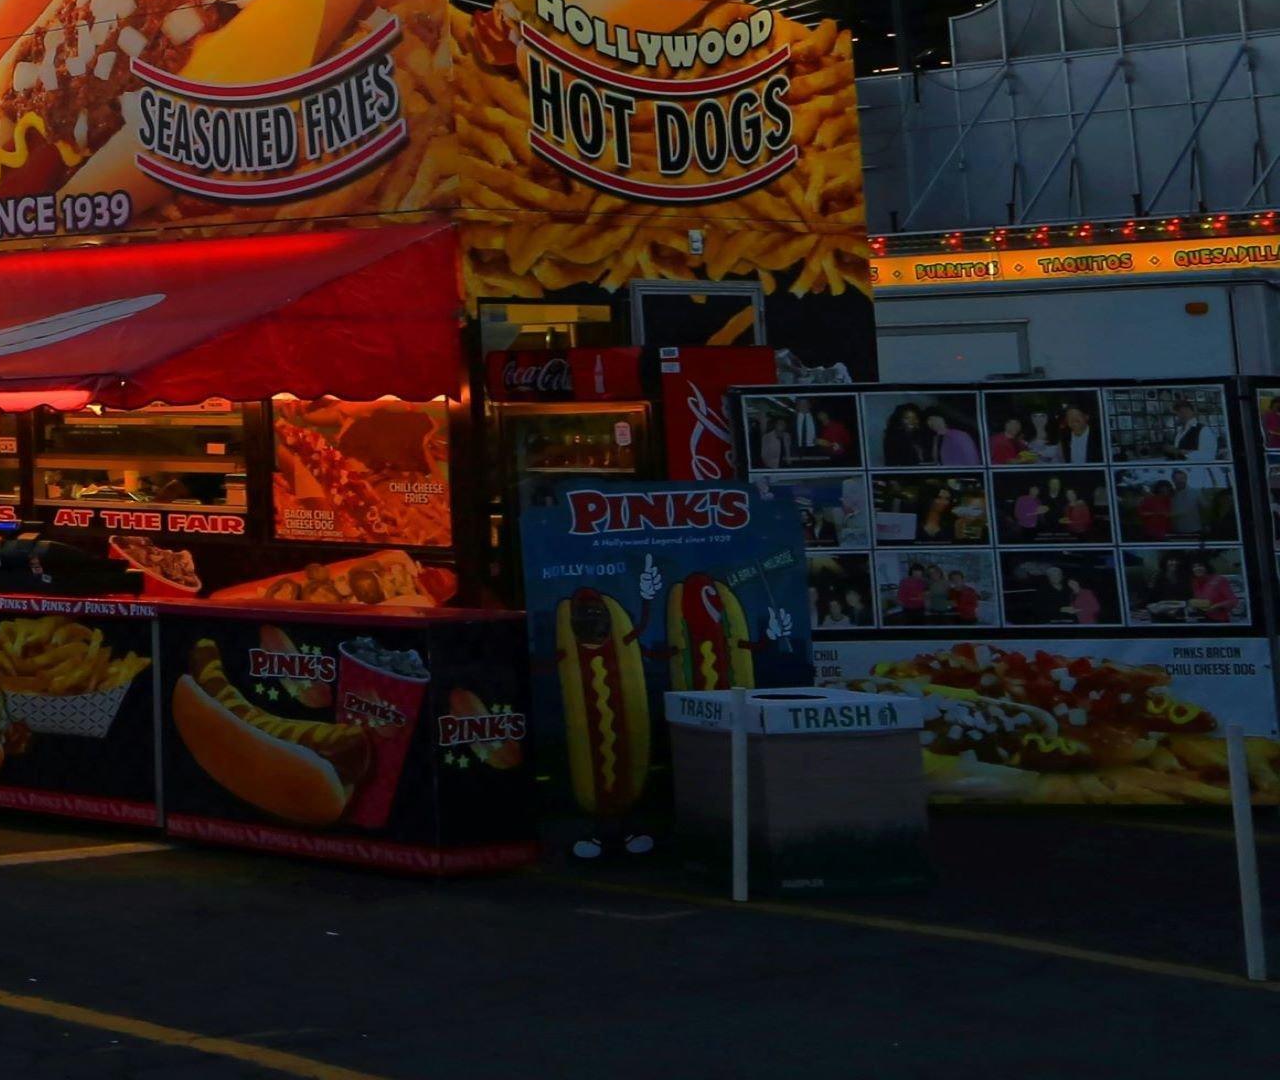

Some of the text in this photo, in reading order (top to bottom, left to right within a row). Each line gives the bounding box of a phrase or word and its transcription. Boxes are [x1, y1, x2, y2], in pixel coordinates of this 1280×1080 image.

[138, 53, 399, 171] SEASONED FRIES
[527, 55, 793, 175] HOT DOGS
[61, 190, 130, 230] 1939
[915, 260, 999, 280] BURRITOS
[1038, 253, 1132, 273] TAQUITOS
[54, 509, 245, 535] AT THE FAIR
[314, 510, 334, 521] CHILI
[566, 489, 750, 535] PINK'S
[285, 519, 334, 530] CHEESE DOG
[543, 563, 626, 579] HOLLYWOOD
[1173, 647, 1242, 658] PINKS BACON
[249, 648, 335, 682] PINK'S
[1166, 663, 1256, 675] CHILI CHEESE DOG
[344, 692, 406, 728] PINK'S
[680, 698, 722, 721] TRASH
[789, 705, 870, 729] TRASH
[438, 713, 527, 746] PINK'S
